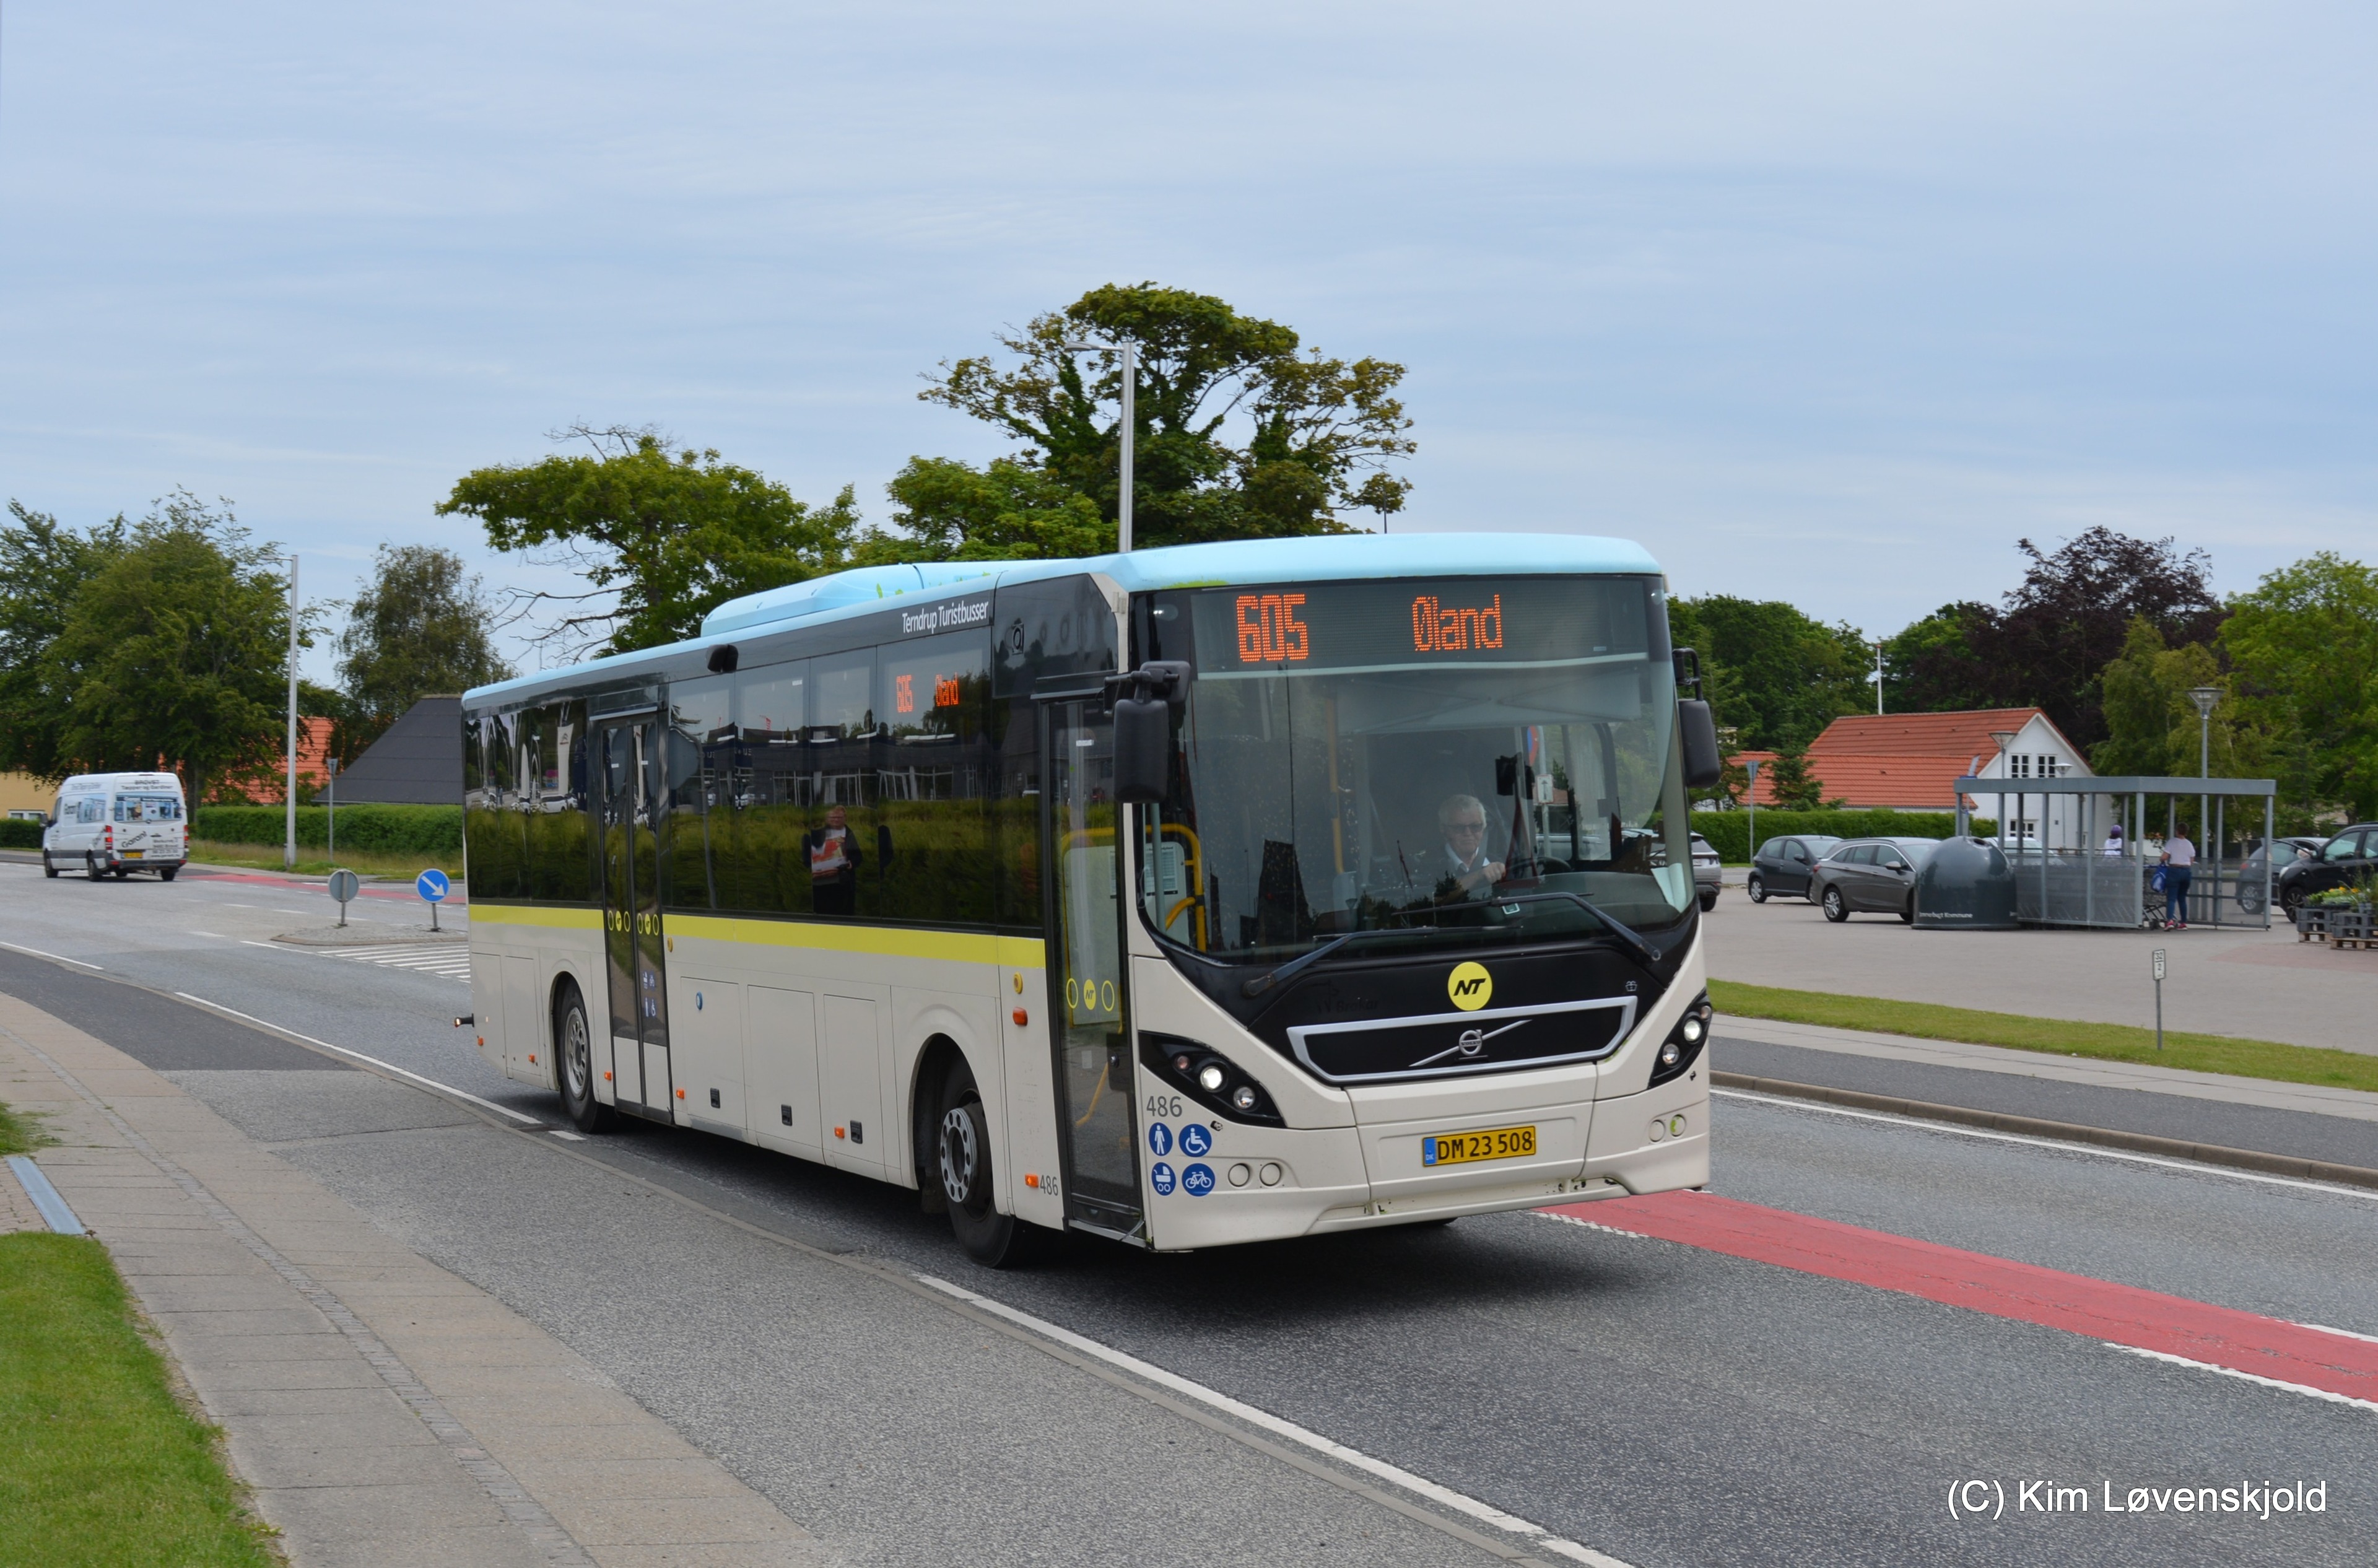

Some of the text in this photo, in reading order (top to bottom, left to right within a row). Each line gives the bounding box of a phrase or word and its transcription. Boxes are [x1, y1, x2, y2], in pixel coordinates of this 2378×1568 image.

[902, 600, 989, 634] Terndrup Turistbusser
[1237, 594, 1502, 662] 605 Øland
[896, 674, 913, 713] 605
[121, 830, 147, 848] Garant
[1086, 990, 1094, 1000] NT
[1453, 978, 1486, 996] NT
[1146, 1095, 1183, 1117] 486
[1437, 1131, 1533, 1160] DM 23 508
[1040, 1175, 1058, 1196] 486
